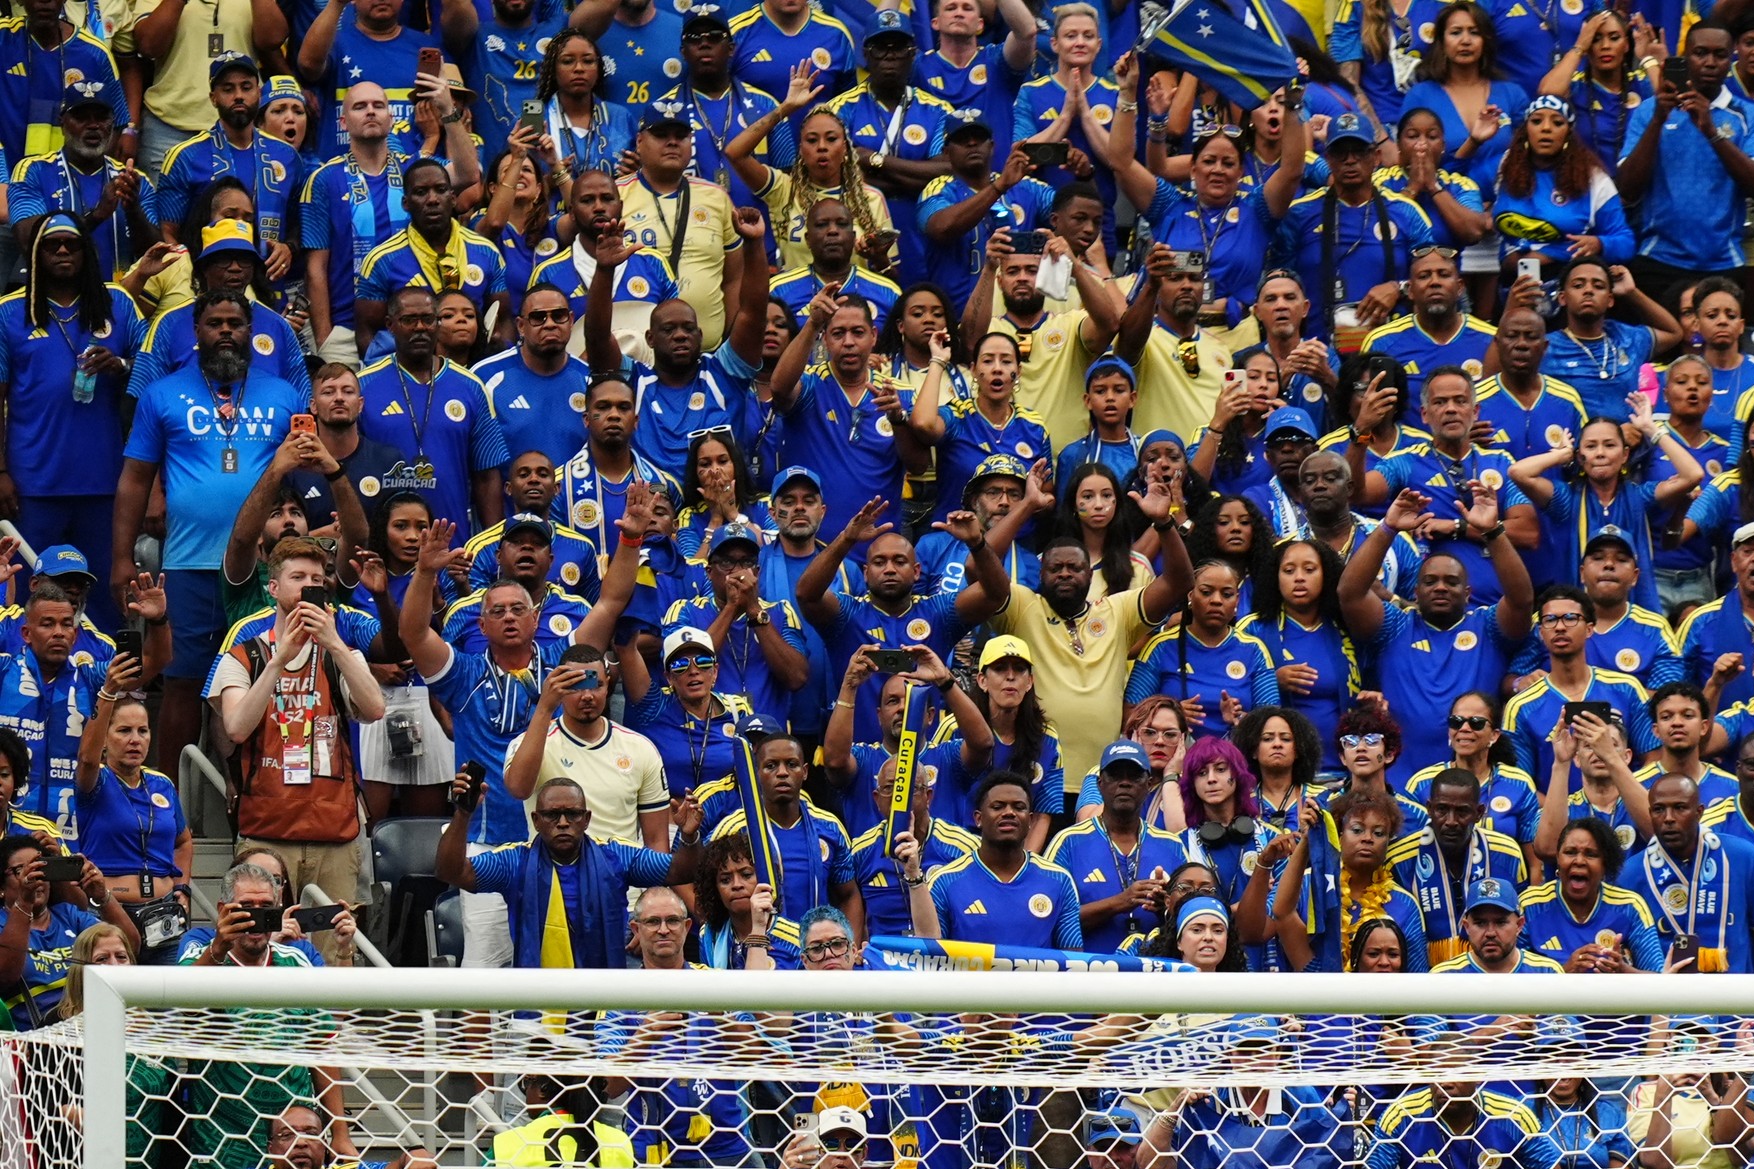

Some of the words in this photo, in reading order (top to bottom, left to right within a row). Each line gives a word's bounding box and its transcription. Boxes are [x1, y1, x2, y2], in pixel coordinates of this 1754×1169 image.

[513, 60, 536, 80] 26
[626, 81, 650, 104] 26
[382, 477, 437, 490] CURAÇAO
[895, 738, 914, 803] Curaçao
[1420, 886, 1431, 912] WAVE
[1430, 886, 1442, 910] BLUE
[1697, 889, 1707, 914] WAVE
[1706, 891, 1716, 915] BLUE
